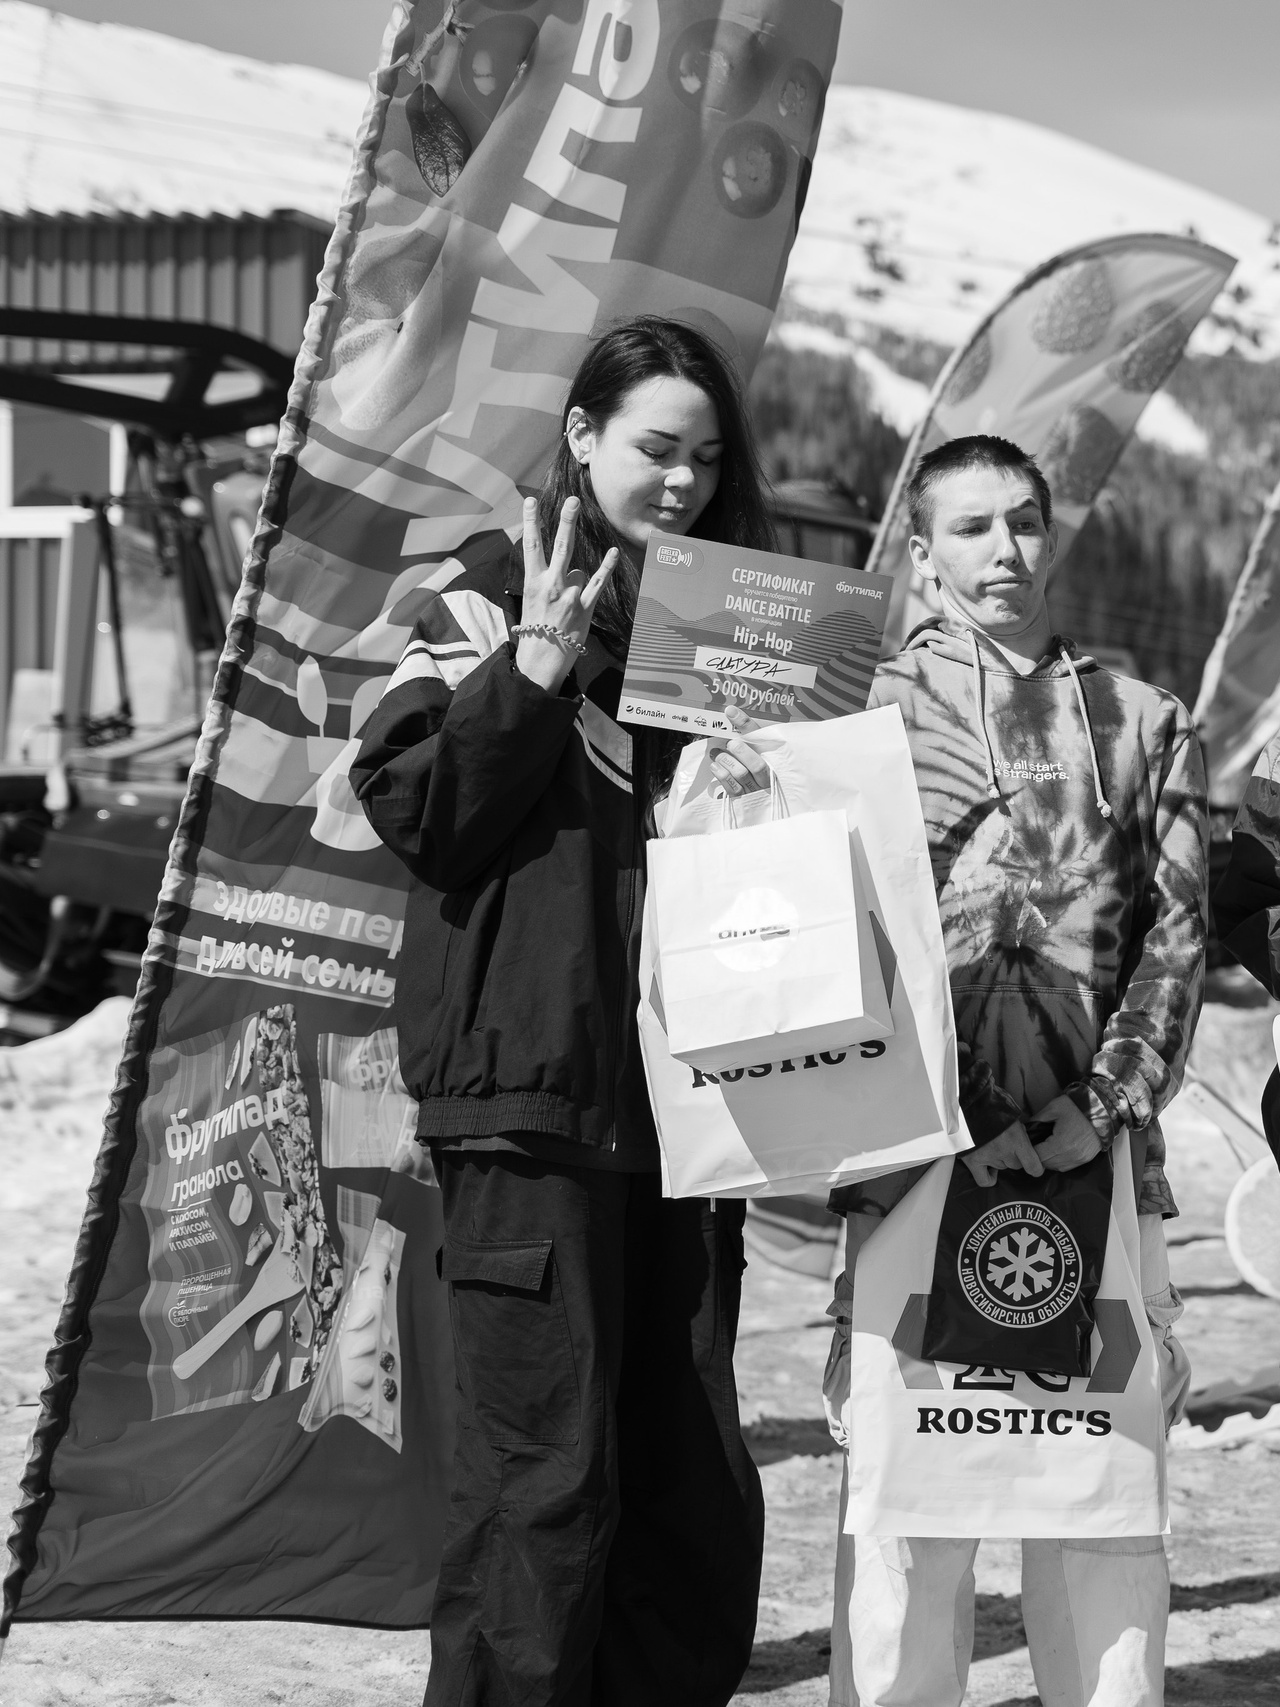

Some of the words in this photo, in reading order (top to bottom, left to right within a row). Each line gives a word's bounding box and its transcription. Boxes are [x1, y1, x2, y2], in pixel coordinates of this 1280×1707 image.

[732, 567, 815, 596] СЕРТИФИКАТ
[744, 587, 769, 598] вручается
[768, 591, 799, 602] победителю
[725, 594, 766, 616] DANCE
[767, 600, 812, 624] BATTLE
[733, 625, 793, 656] Hip-Hop
[711, 678, 720, 694] 5
[722, 680, 749, 699] 000
[749, 688, 795, 706] рублей
[635, 706, 666, 719] билайн
[993, 759, 1011, 769] We
[1013, 760, 1028, 770] all
[1029, 762, 1064, 772] start
[1002, 768, 1069, 782] strangers.
[165, 1086, 290, 1165] фрутилад
[171, 1160, 244, 1208] гранола
[169, 1242, 176, 1252] И
[176, 1229, 219, 1251] ПАПАЙЕЙ
[966, 1204, 1023, 1253] ХОККЕЙНЫЙ
[1026, 1207, 1053, 1227] КЛУБ
[1051, 1224, 1077, 1266] СИБИРЬ
[177, 1282, 214, 1296] ПШЕНИЦА
[180, 1267, 232, 1287] ПРОРОЩЕННАЯ
[961, 1267, 1036, 1325] НОВОСИБИРСКАЯ
[1037, 1281, 1077, 1321] ОБЛАСТЬ
[178, 1305, 209, 1316] ЯБЛОЧНЫМ
[916, 1407, 1112, 1437] ROSTIC'S
